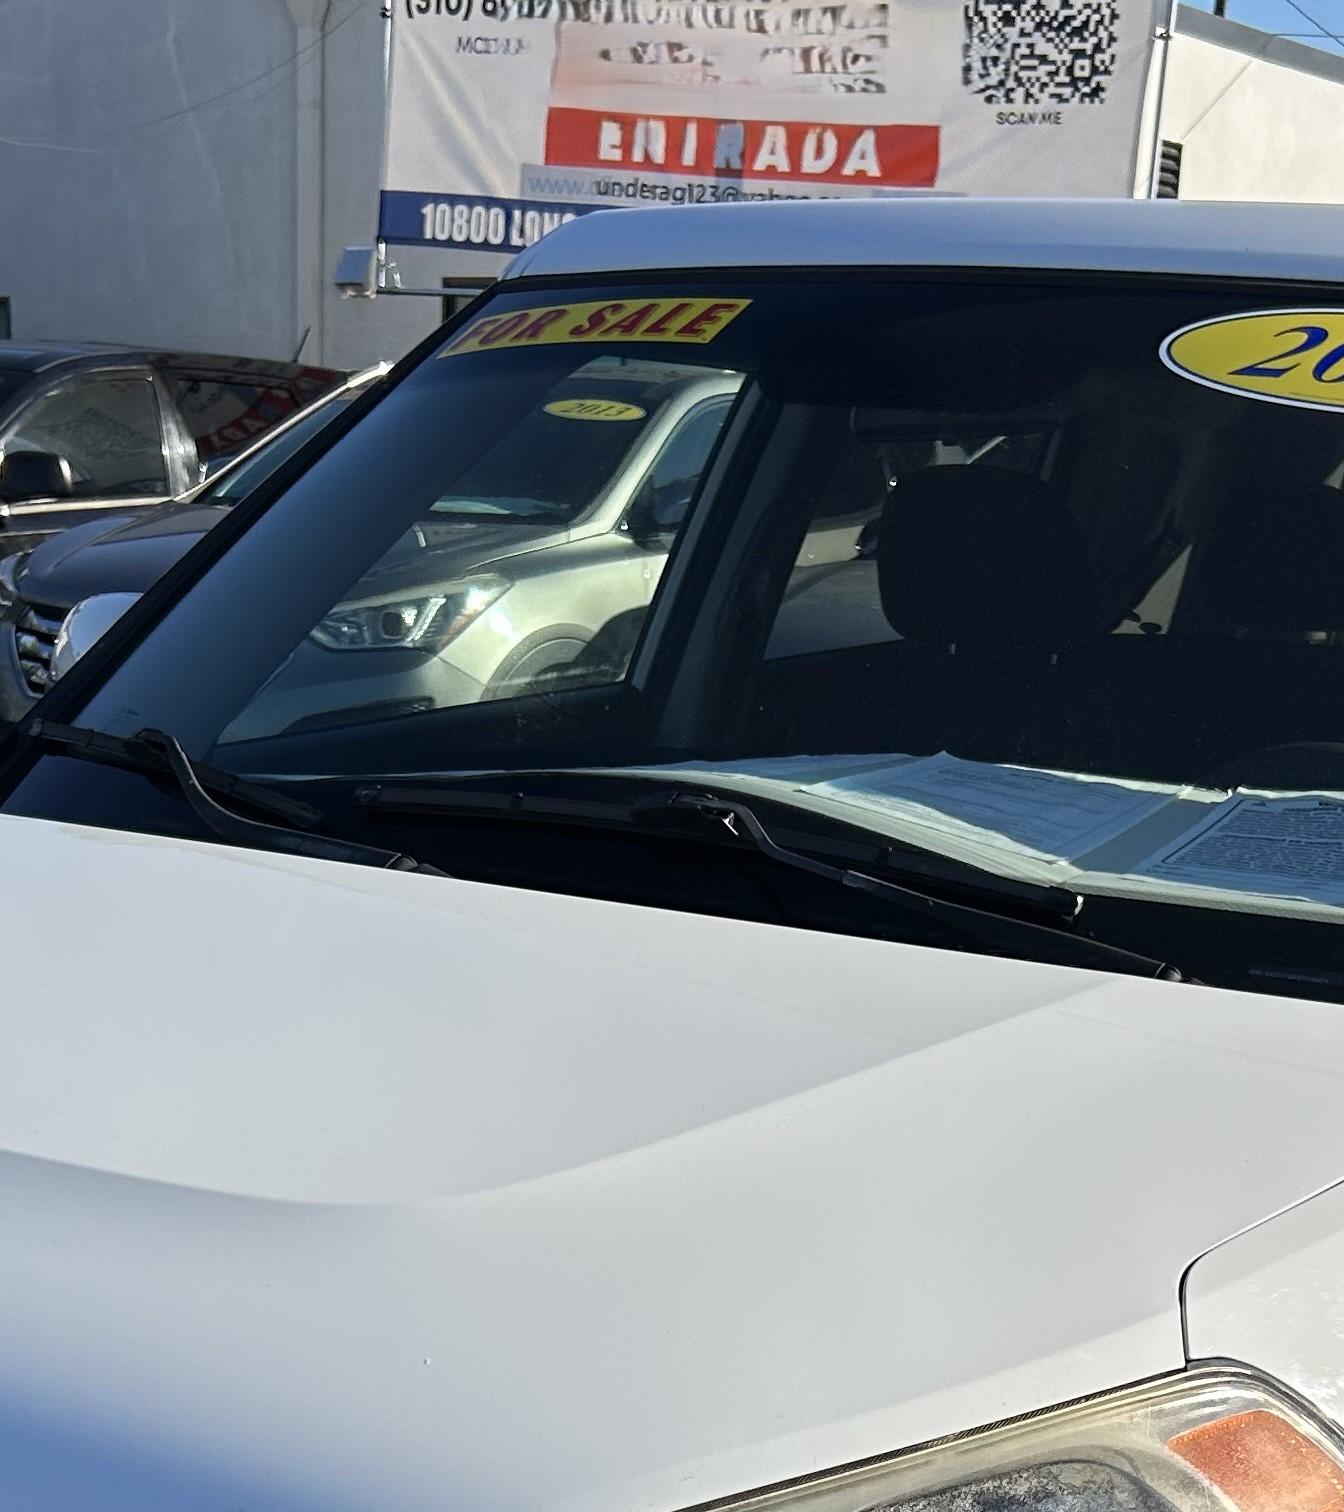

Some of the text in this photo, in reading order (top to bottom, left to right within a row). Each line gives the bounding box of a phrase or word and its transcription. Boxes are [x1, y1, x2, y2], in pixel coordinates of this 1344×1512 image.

[421, 202, 506, 246] 10800
[454, 303, 737, 348] FOR SALE
[562, 402, 634, 418] 2013
